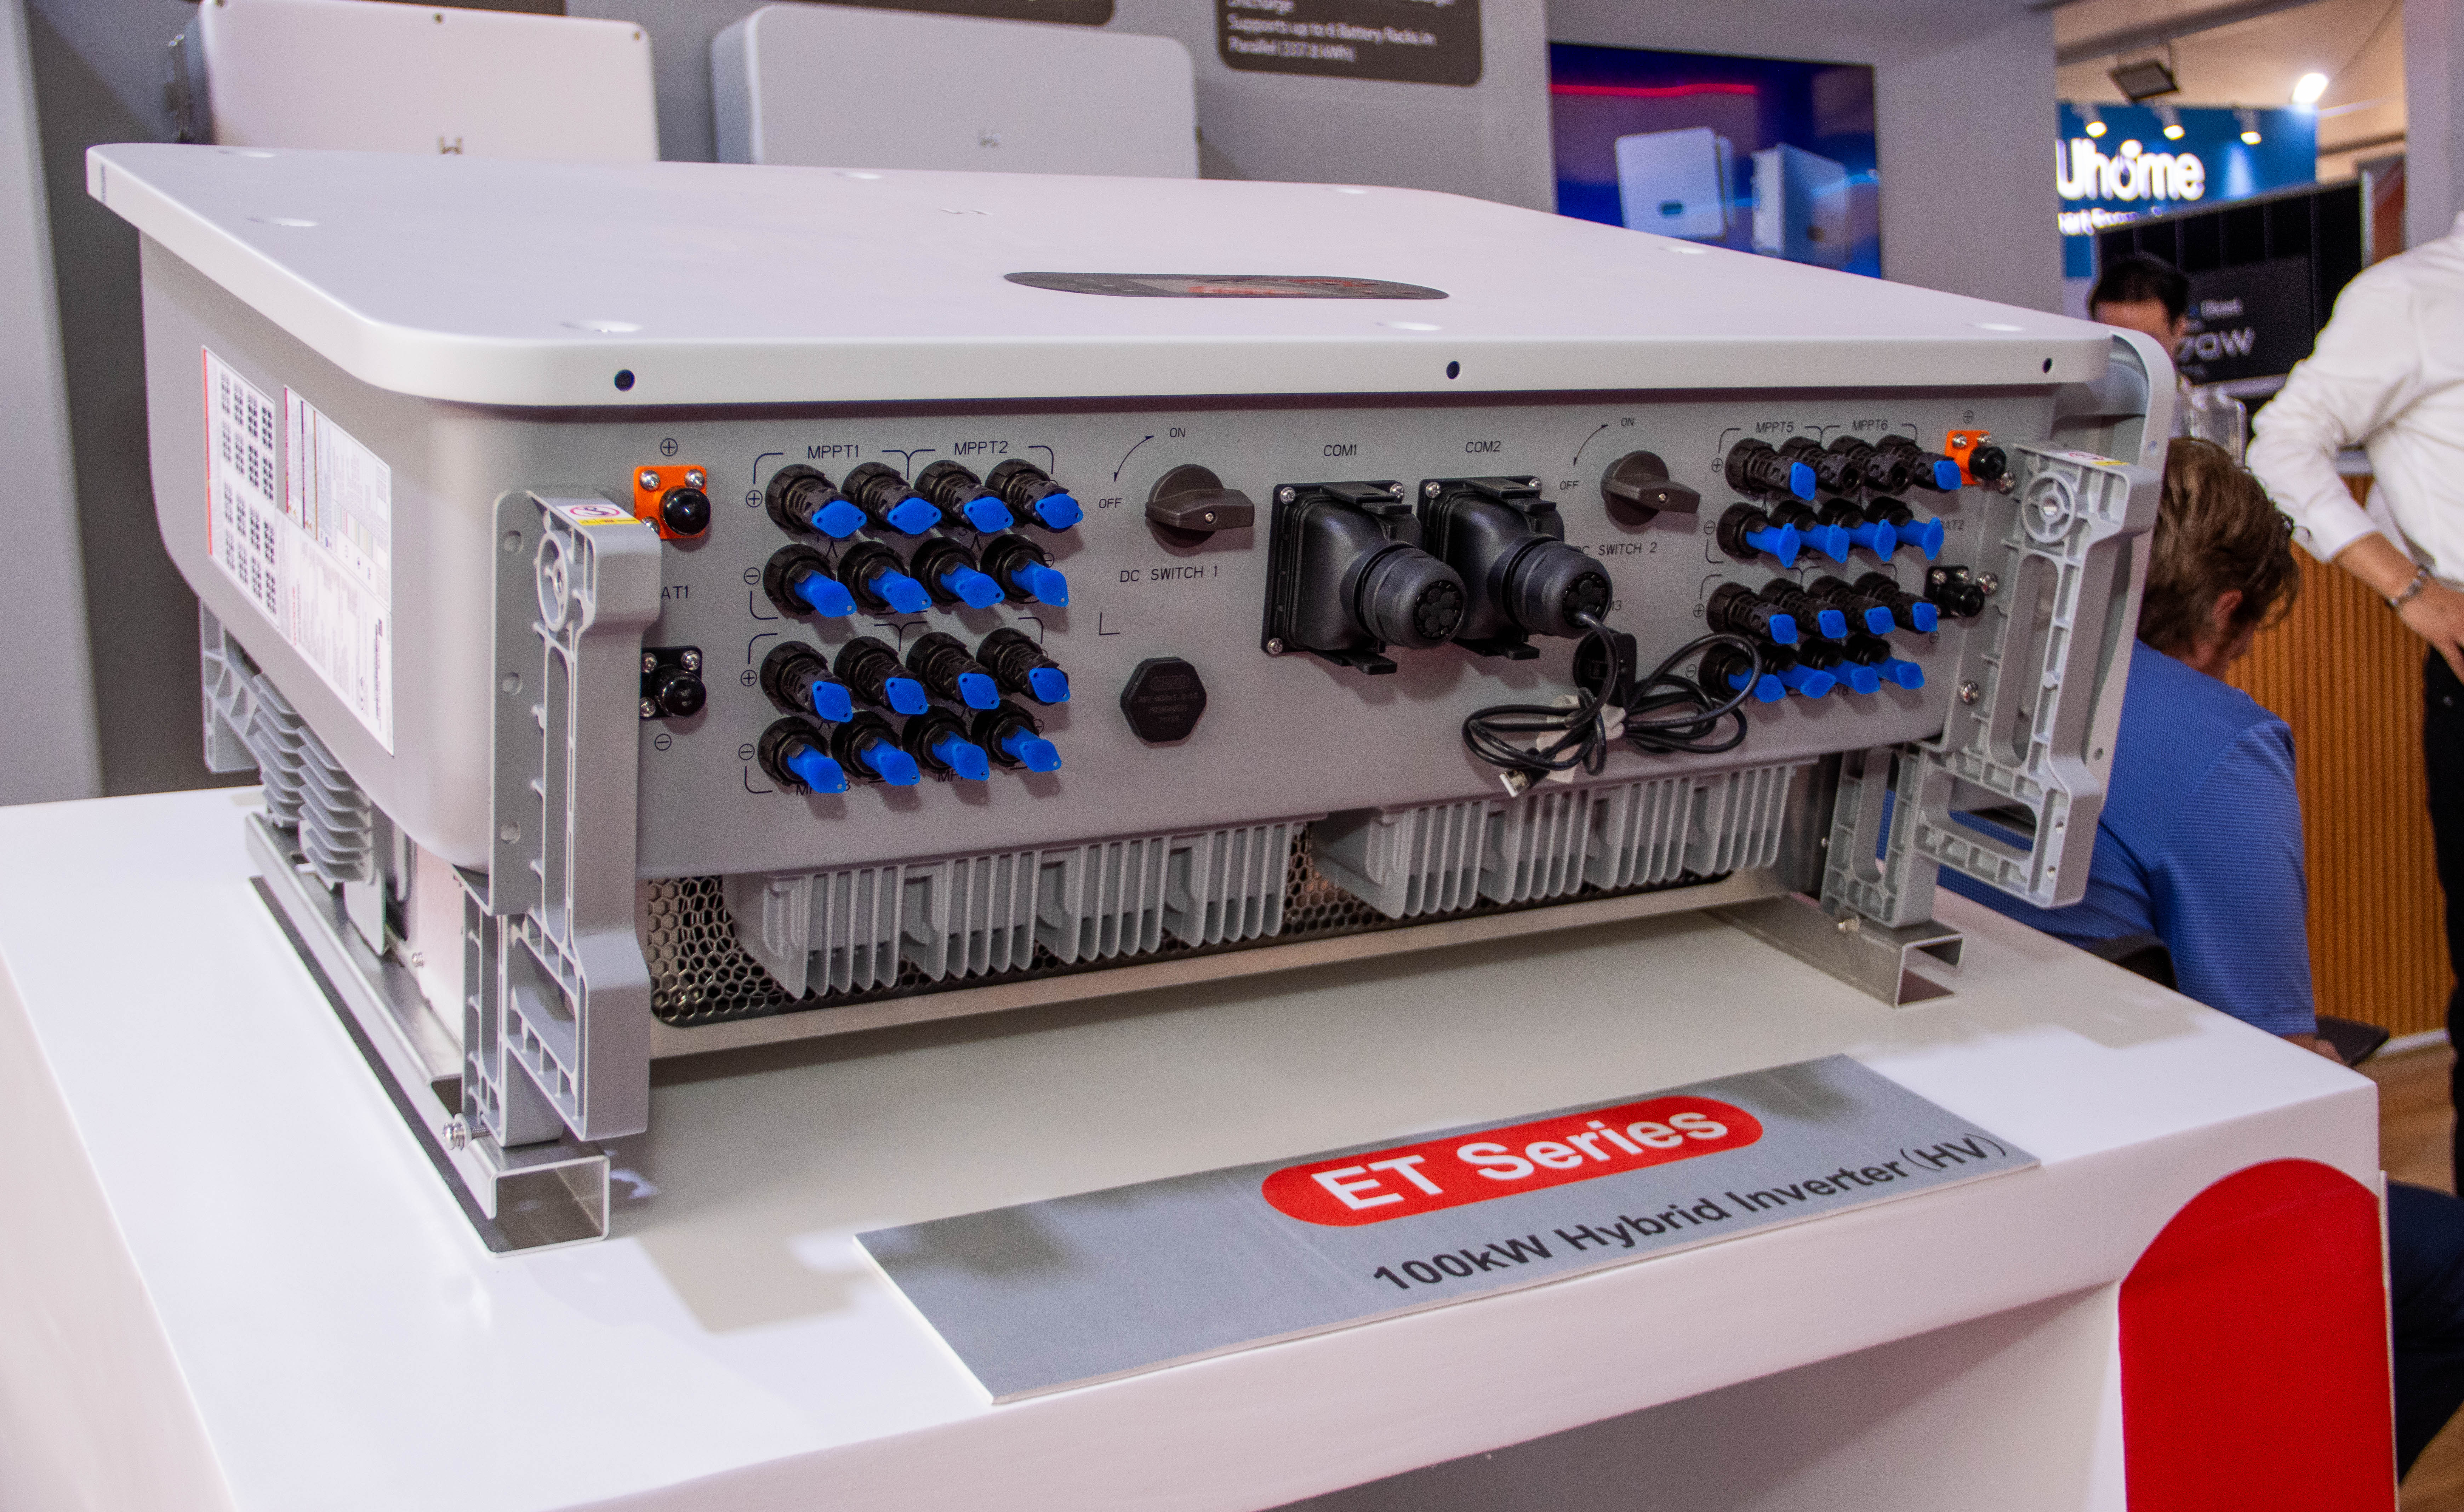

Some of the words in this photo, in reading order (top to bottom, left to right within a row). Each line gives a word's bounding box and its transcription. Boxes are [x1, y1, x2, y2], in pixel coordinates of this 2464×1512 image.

[1227, 13, 1289, 34] Supports
[1291, 23, 1308, 38] up
[1309, 22, 1325, 37] to
[1337, 22, 1383, 45] Battery
[1384, 26, 1419, 44] Racks
[1420, 30, 1437, 46] in
[1228, 36, 1277, 56] Parallel
[1620, 418, 1635, 427] ON
[1756, 421, 1794, 433] MPPT5
[1852, 419, 1888, 431] MPPT6
[1169, 428, 1186, 438] ON
[807, 445, 859, 459] MPPT1
[954, 441, 1008, 455] MPPT2
[1323, 444, 1358, 457] COM1
[1465, 441, 1501, 453] COM2
[1559, 481, 1579, 490] OFF
[1099, 498, 1122, 509] OFF
[1598, 543, 1642, 556] SWITCH
[1650, 542, 1657, 553] 2
[1120, 570, 1140, 582] DC
[1151, 566, 1204, 581] SWITCH
[1214, 566, 1218, 577] 1
[661, 585, 689, 599] AT1
[1311, 1155, 1443, 1210] ET
[1456, 1111, 1729, 1180] Series
[1374, 1234, 1553, 1289] 100kW
[1553, 1197, 1732, 1248] Hybrid
